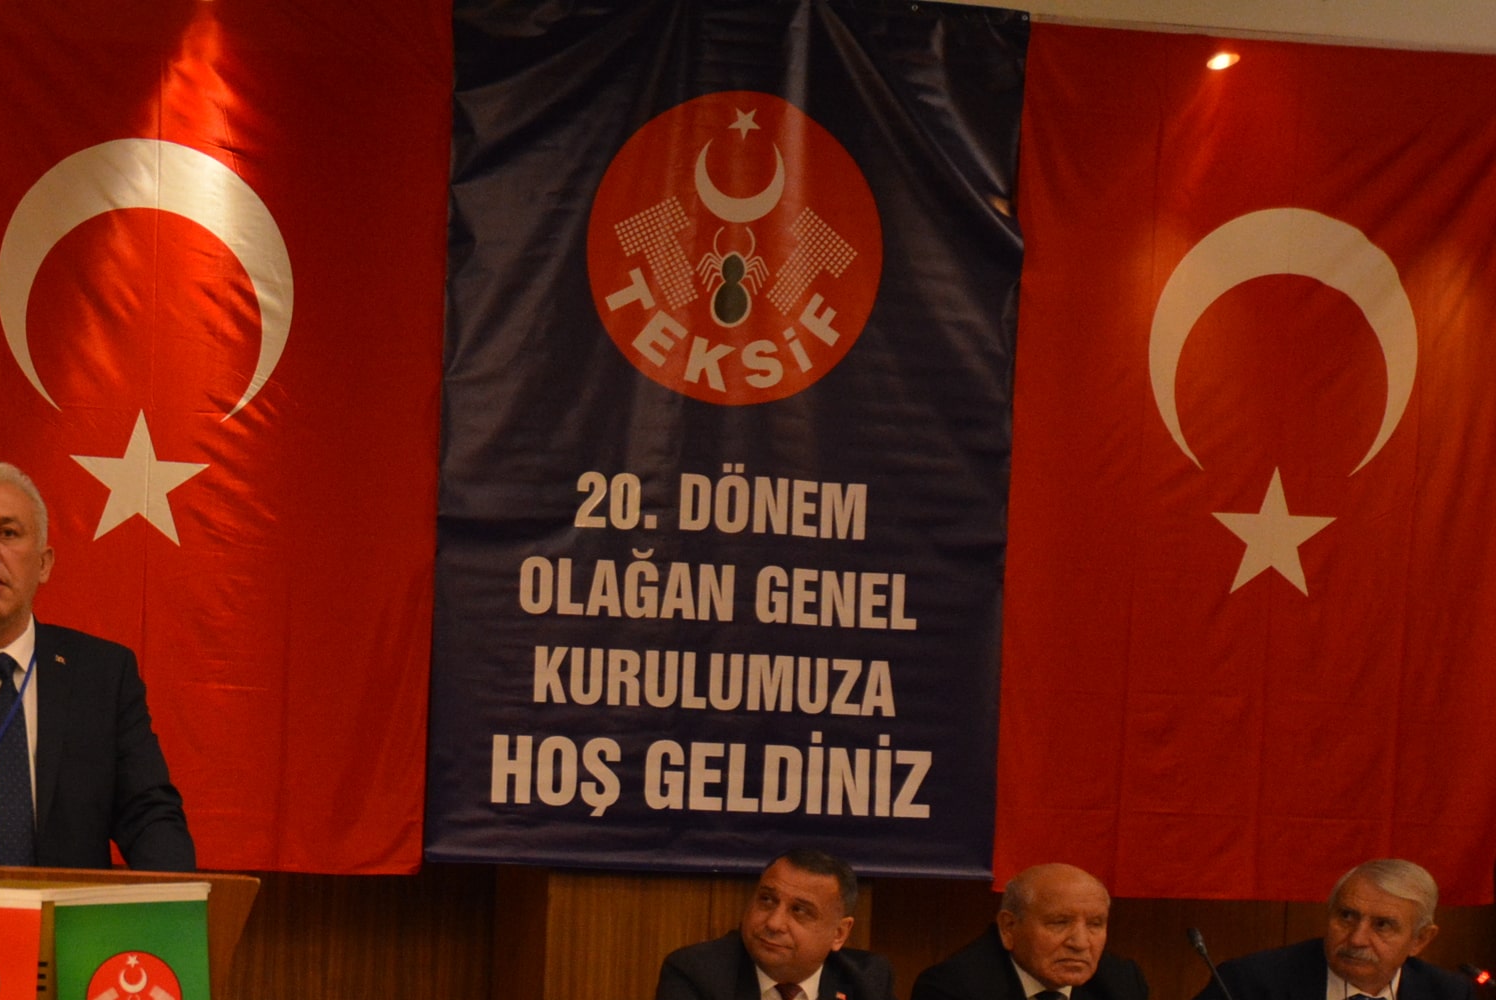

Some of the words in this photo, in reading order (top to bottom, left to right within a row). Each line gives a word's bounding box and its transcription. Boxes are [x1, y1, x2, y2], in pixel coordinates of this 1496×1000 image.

[605, 267, 841, 393] TEKSİF
[574, 471, 658, 530] 20.
[679, 463, 868, 541] DÖNEM
[519, 547, 736, 622] OLAĞAN
[756, 565, 918, 631] GENEL
[533, 645, 897, 718] KURULUMUZA
[490, 733, 622, 817] HOŞ
[644, 730, 934, 819] GELDİNİZ
